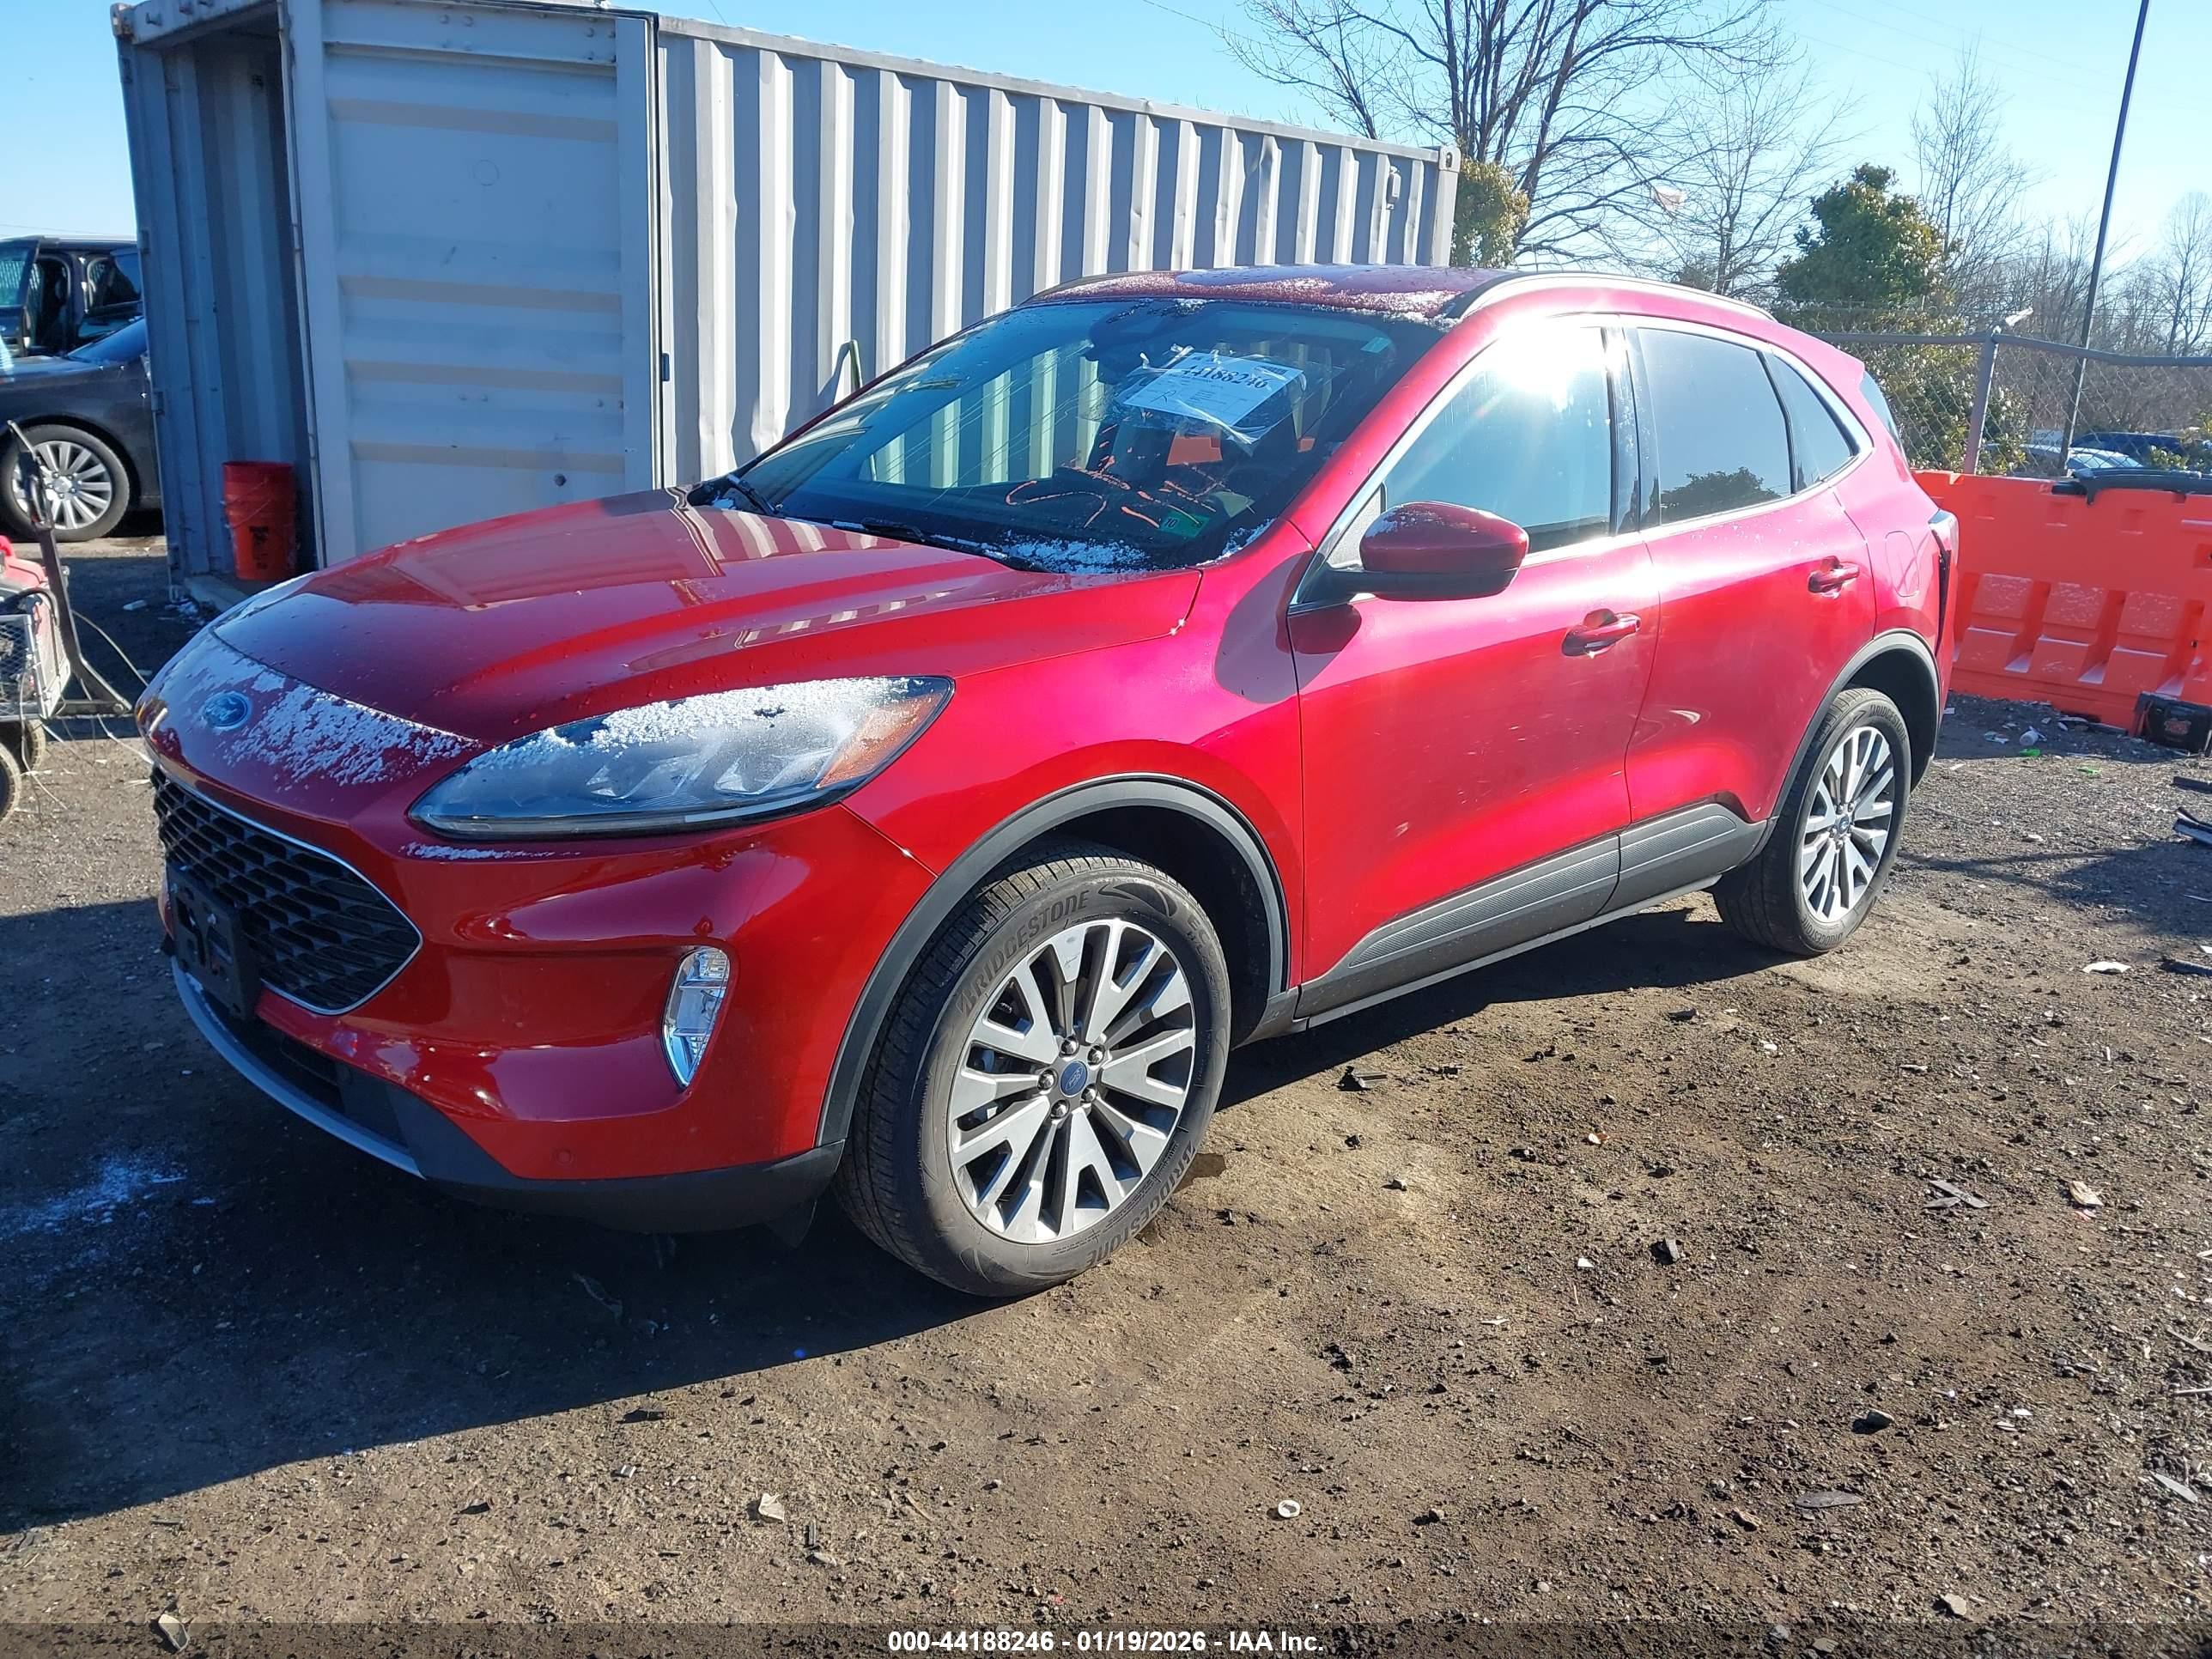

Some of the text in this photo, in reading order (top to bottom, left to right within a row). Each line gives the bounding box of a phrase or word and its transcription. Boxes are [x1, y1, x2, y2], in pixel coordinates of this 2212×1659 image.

[1182, 365, 1268, 389] 44188246
[957, 890, 1090, 1018] BRIDGESTONE
[1085, 1140, 1196, 1267] BRIDGESTONE
